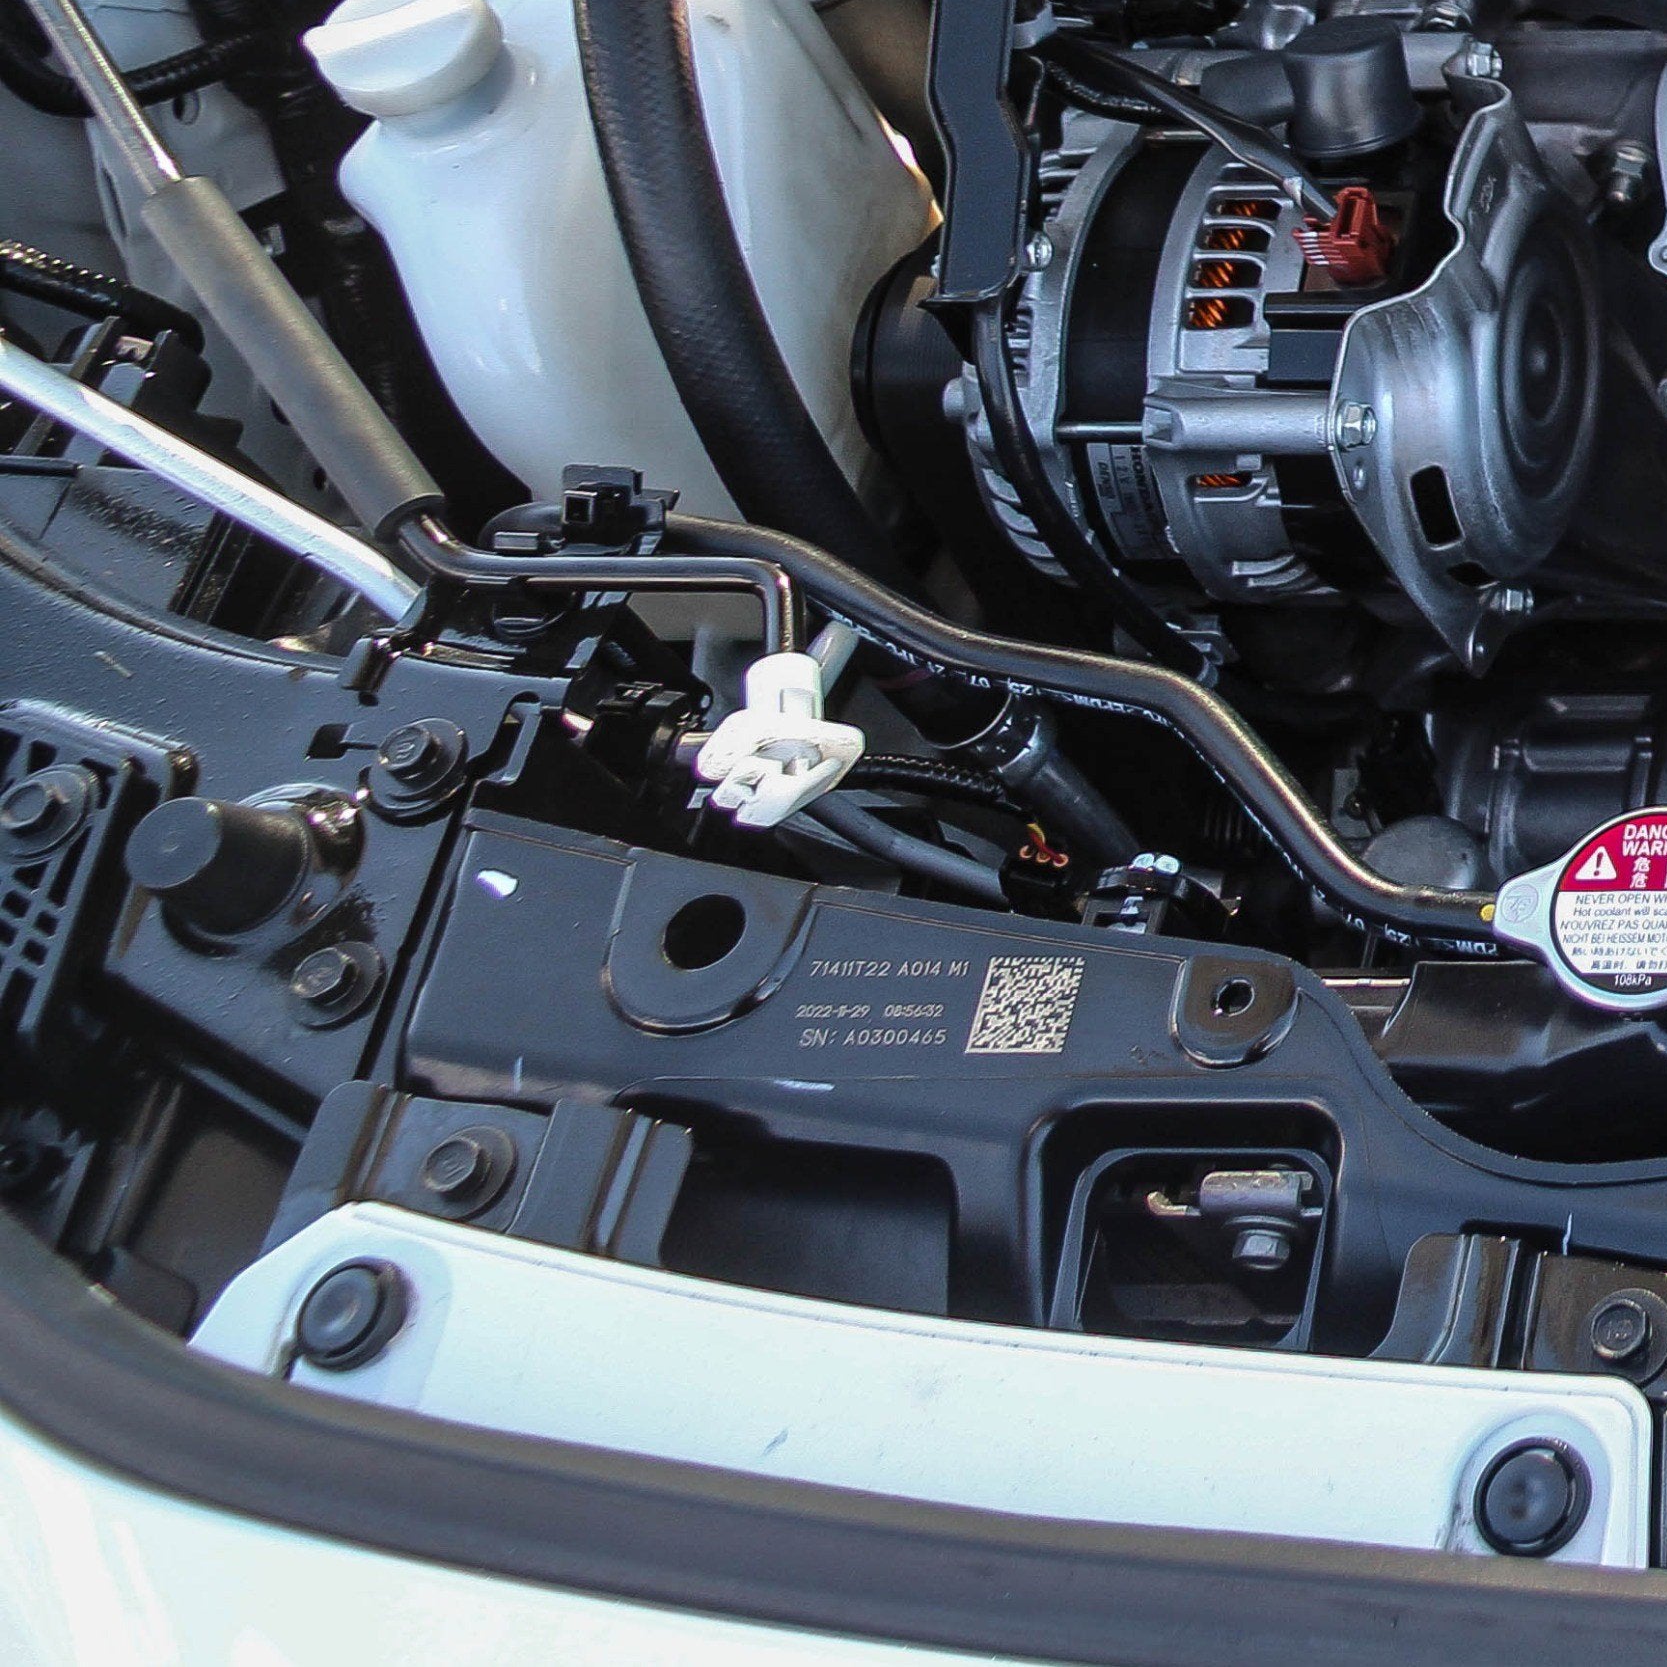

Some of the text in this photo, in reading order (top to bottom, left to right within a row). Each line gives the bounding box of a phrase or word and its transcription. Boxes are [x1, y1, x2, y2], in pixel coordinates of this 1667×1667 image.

[1575, 894, 1614, 905] NEVER
[1617, 894, 1650, 905] OPEN
[1572, 908, 1592, 917] Hot
[1593, 907, 1631, 917] coolant
[1634, 907, 1650, 917] will
[1617, 919, 1639, 930] PAS
[1562, 933, 1589, 944] NICHT
[1590, 933, 1605, 944] BEI
[1606, 933, 1645, 944] HEISSEM
[809, 960, 971, 978] 71411T22 A014 M1
[1613, 974, 1653, 986] 108kPa
[799, 1027, 949, 1048] SN: A0300465
